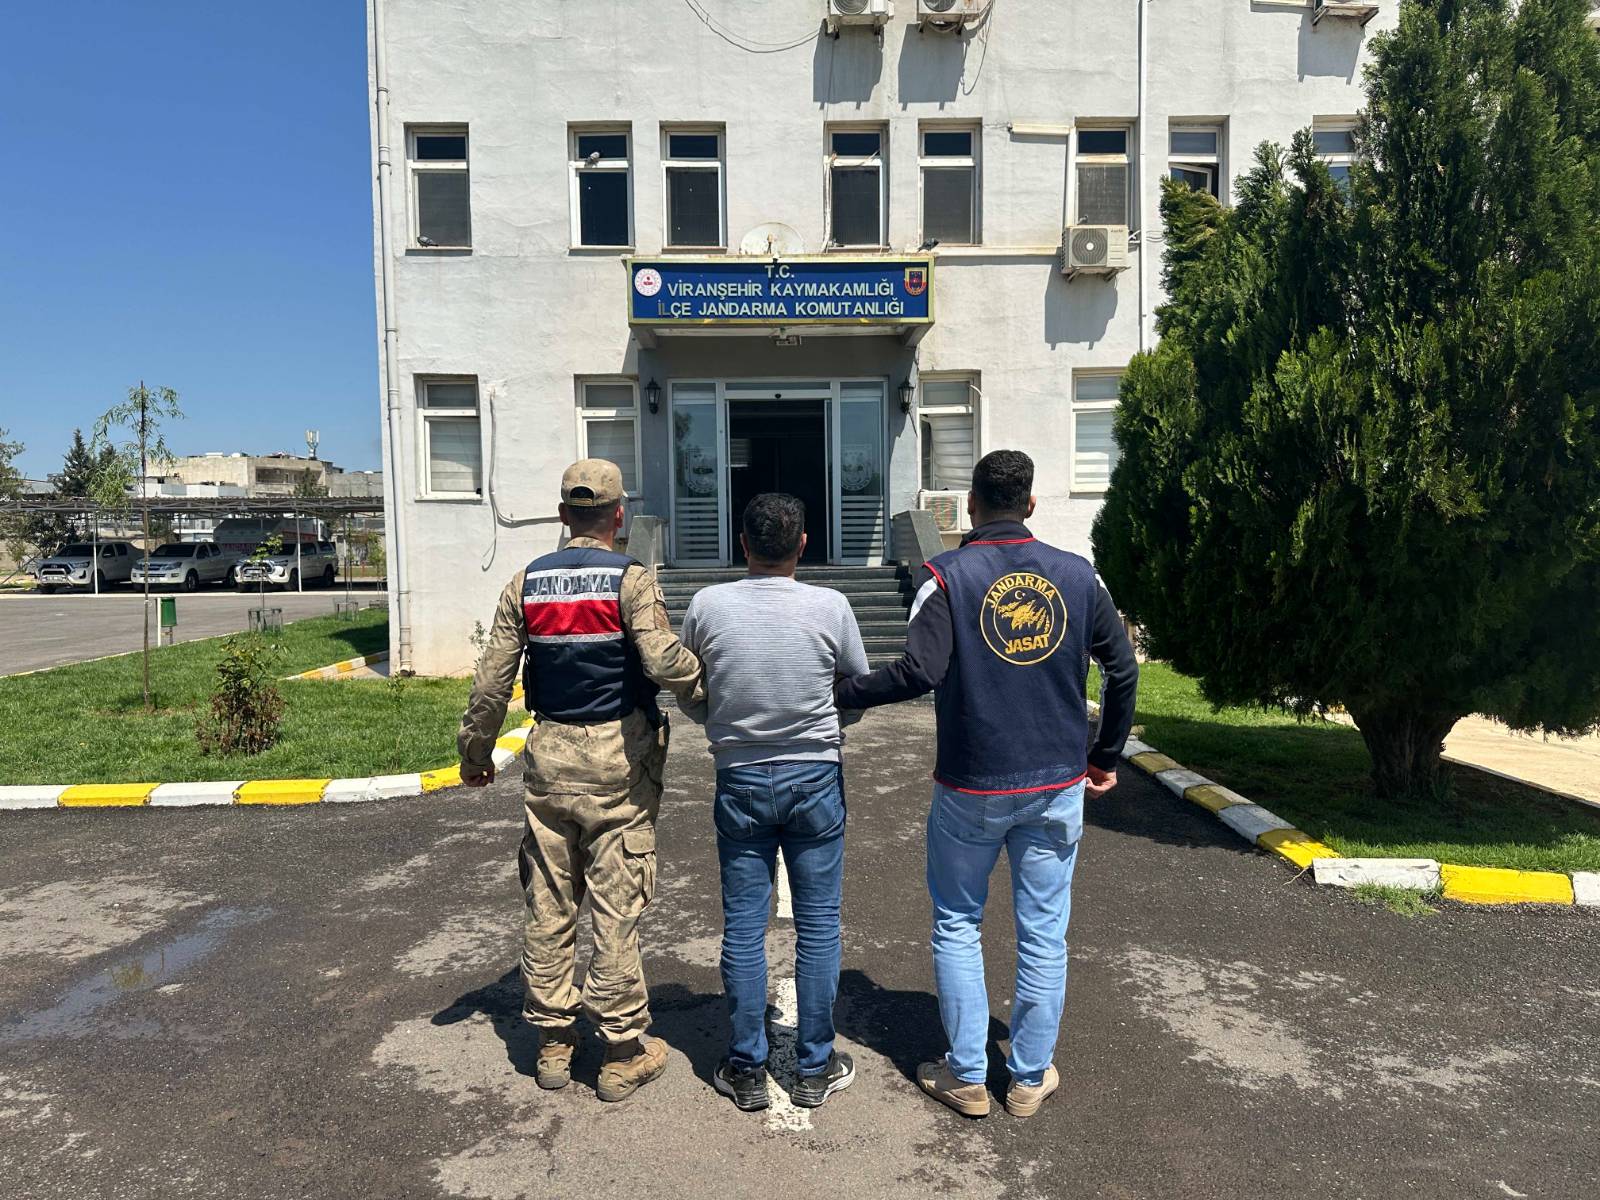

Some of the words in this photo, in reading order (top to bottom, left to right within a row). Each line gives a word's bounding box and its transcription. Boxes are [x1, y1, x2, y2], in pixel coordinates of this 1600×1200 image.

[764, 264, 795, 279] T.C.
[667, 279, 763, 300] VİRANŞEHİR
[770, 278, 894, 297] KAYMAKAMLIĞI
[657, 299, 692, 318] İLÇE
[698, 302, 787, 316] JANDARMA
[795, 297, 904, 316] KOMUTANLIĞI
[531, 574, 612, 596] JANDARMA
[987, 575, 1056, 609] JANDARMA
[1005, 634, 1050, 654] JASAT
